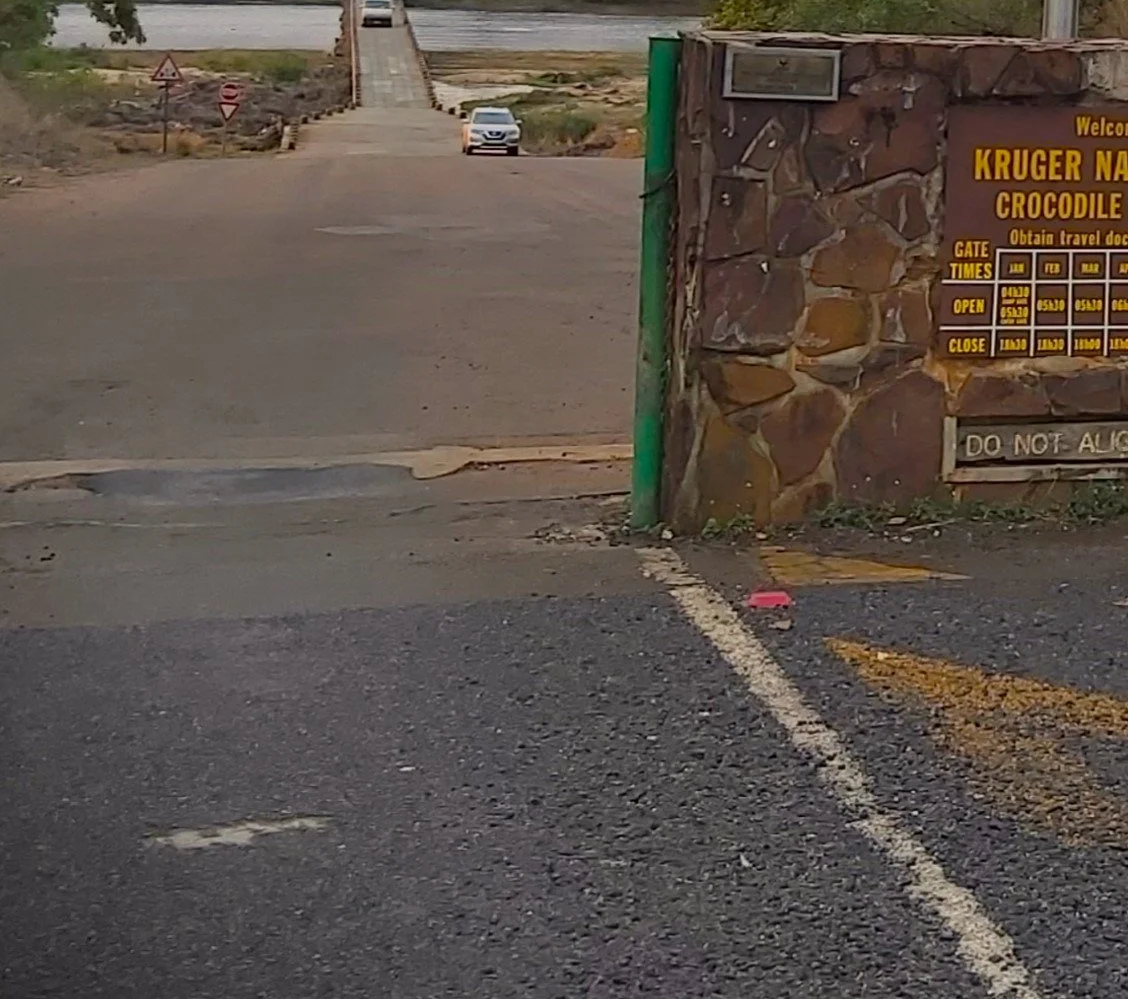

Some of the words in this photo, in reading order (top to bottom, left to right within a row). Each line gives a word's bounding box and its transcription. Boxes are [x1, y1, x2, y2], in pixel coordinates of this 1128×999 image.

[974, 149, 1082, 182] KRUGER
[996, 191, 1123, 220] CROCODILE
[1010, 229, 1054, 246] Obtain
[1060, 229, 1100, 246] travel
[954, 241, 989, 258] GATE
[950, 263, 992, 279] TIMES
[1045, 263, 1060, 274] FEB
[954, 299, 985, 314] OPEN
[1037, 299, 1065, 312] 05h30
[1075, 299, 1103, 312] 05h30
[949, 338, 986, 353] CLOSE
[966, 434, 1001, 457] DO
[1014, 432, 1063, 456] NOT
